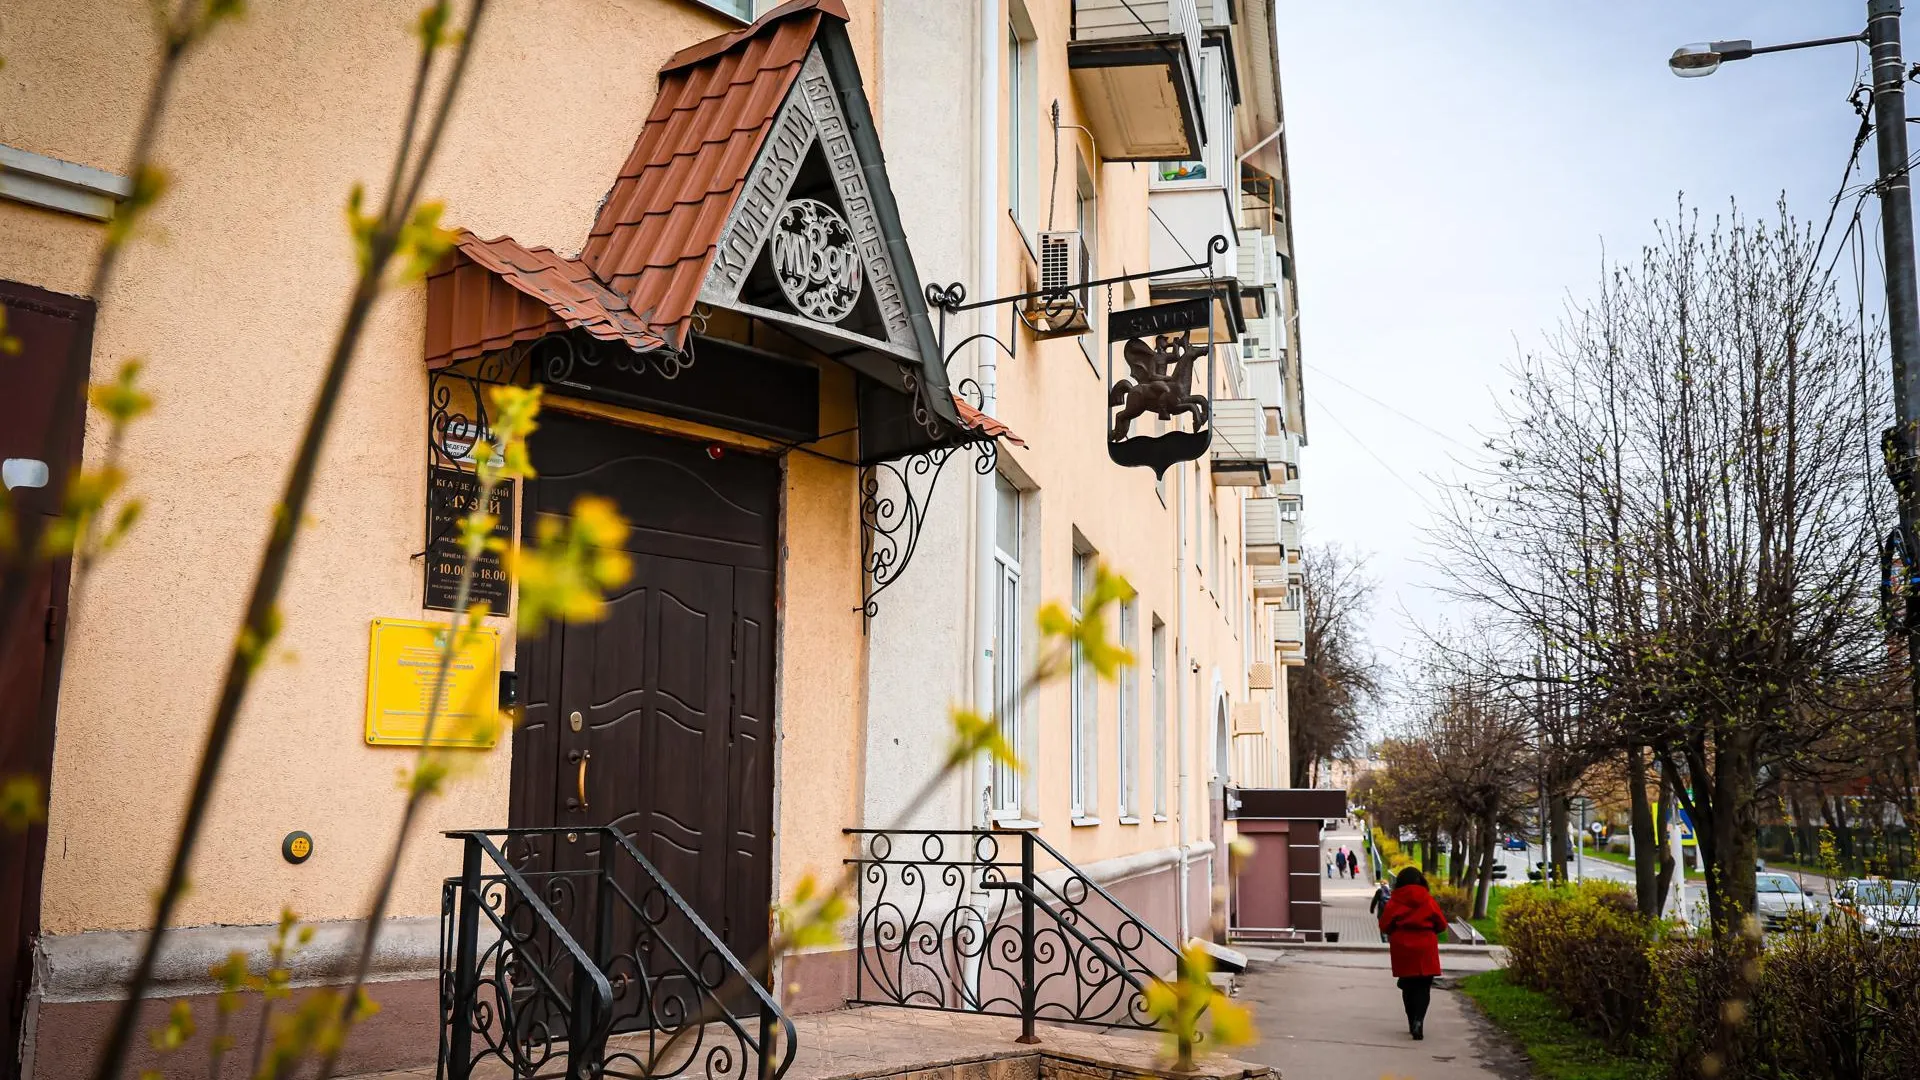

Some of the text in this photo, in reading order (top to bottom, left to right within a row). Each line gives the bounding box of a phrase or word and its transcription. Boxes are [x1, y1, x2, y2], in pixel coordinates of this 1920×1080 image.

[713, 102, 815, 288] КЛИНСКИЙ
[804, 75, 911, 334] КРАЕВЕДЧЕСКИЙ
[480, 568, 506, 582] 18.00
